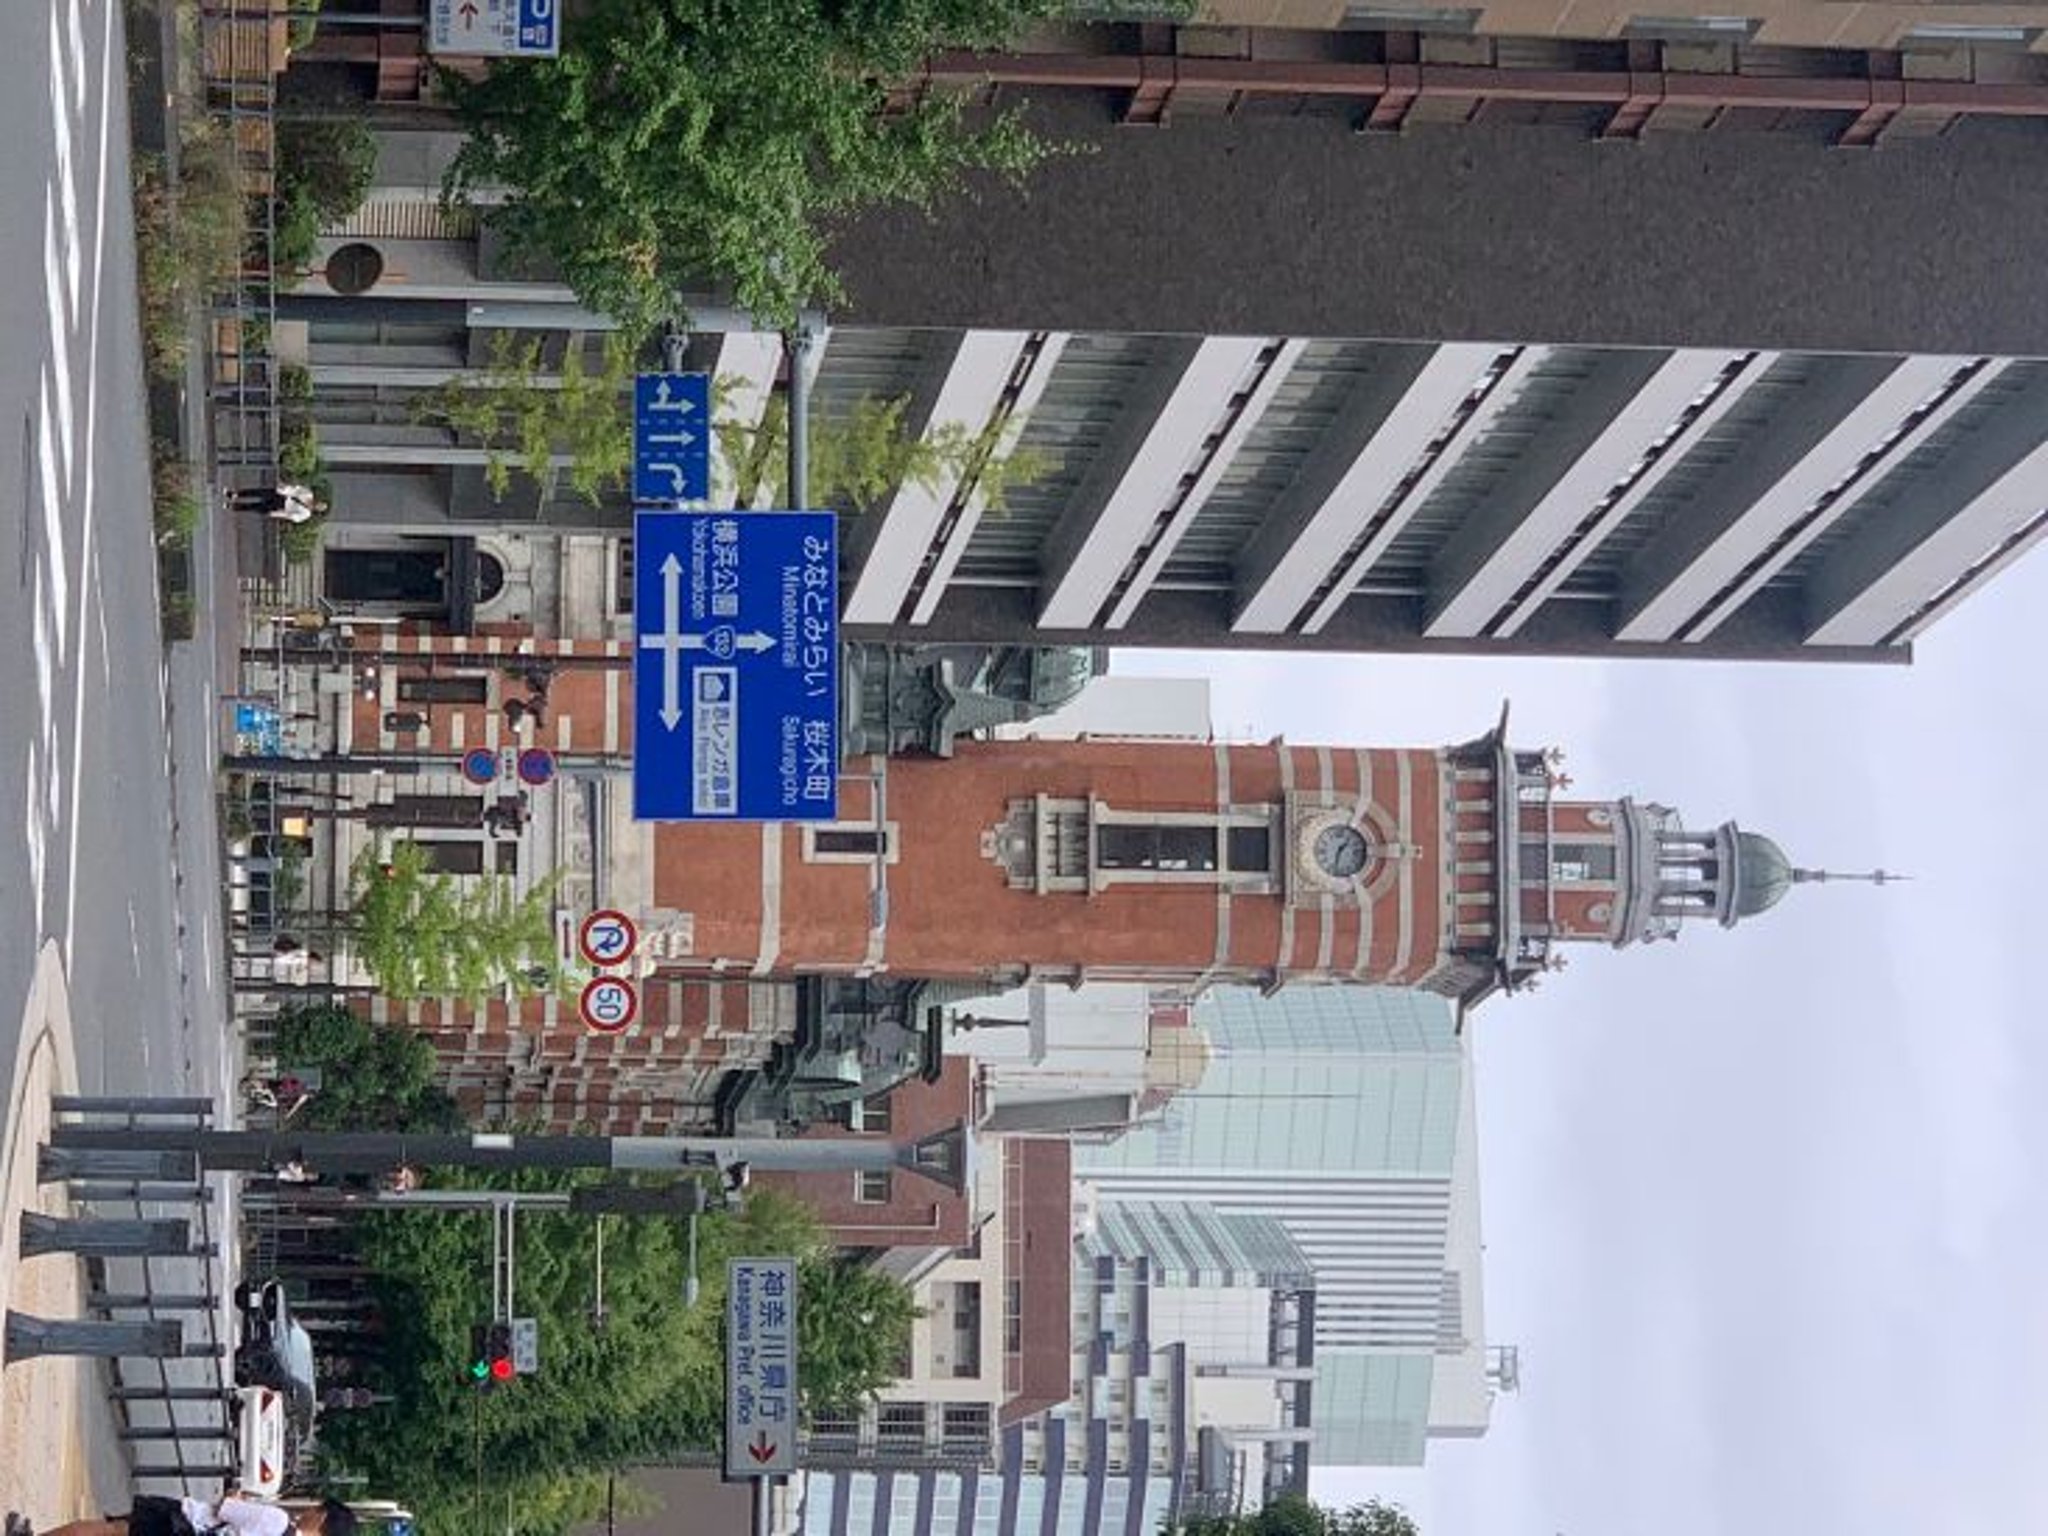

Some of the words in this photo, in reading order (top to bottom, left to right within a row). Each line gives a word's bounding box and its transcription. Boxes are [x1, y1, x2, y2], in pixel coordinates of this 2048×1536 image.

[712, 519, 739, 616] 横浜公園
[782, 566, 799, 668] Minatomirai
[803, 535, 830, 697] みなとみらい
[779, 715, 799, 806] Sakuragicho
[803, 719, 831, 801] 桜木町
[596, 987, 622, 1020] 50
[735, 1267, 754, 1341] Kanagawa
[759, 1269, 787, 1422] 神奈川県庁
